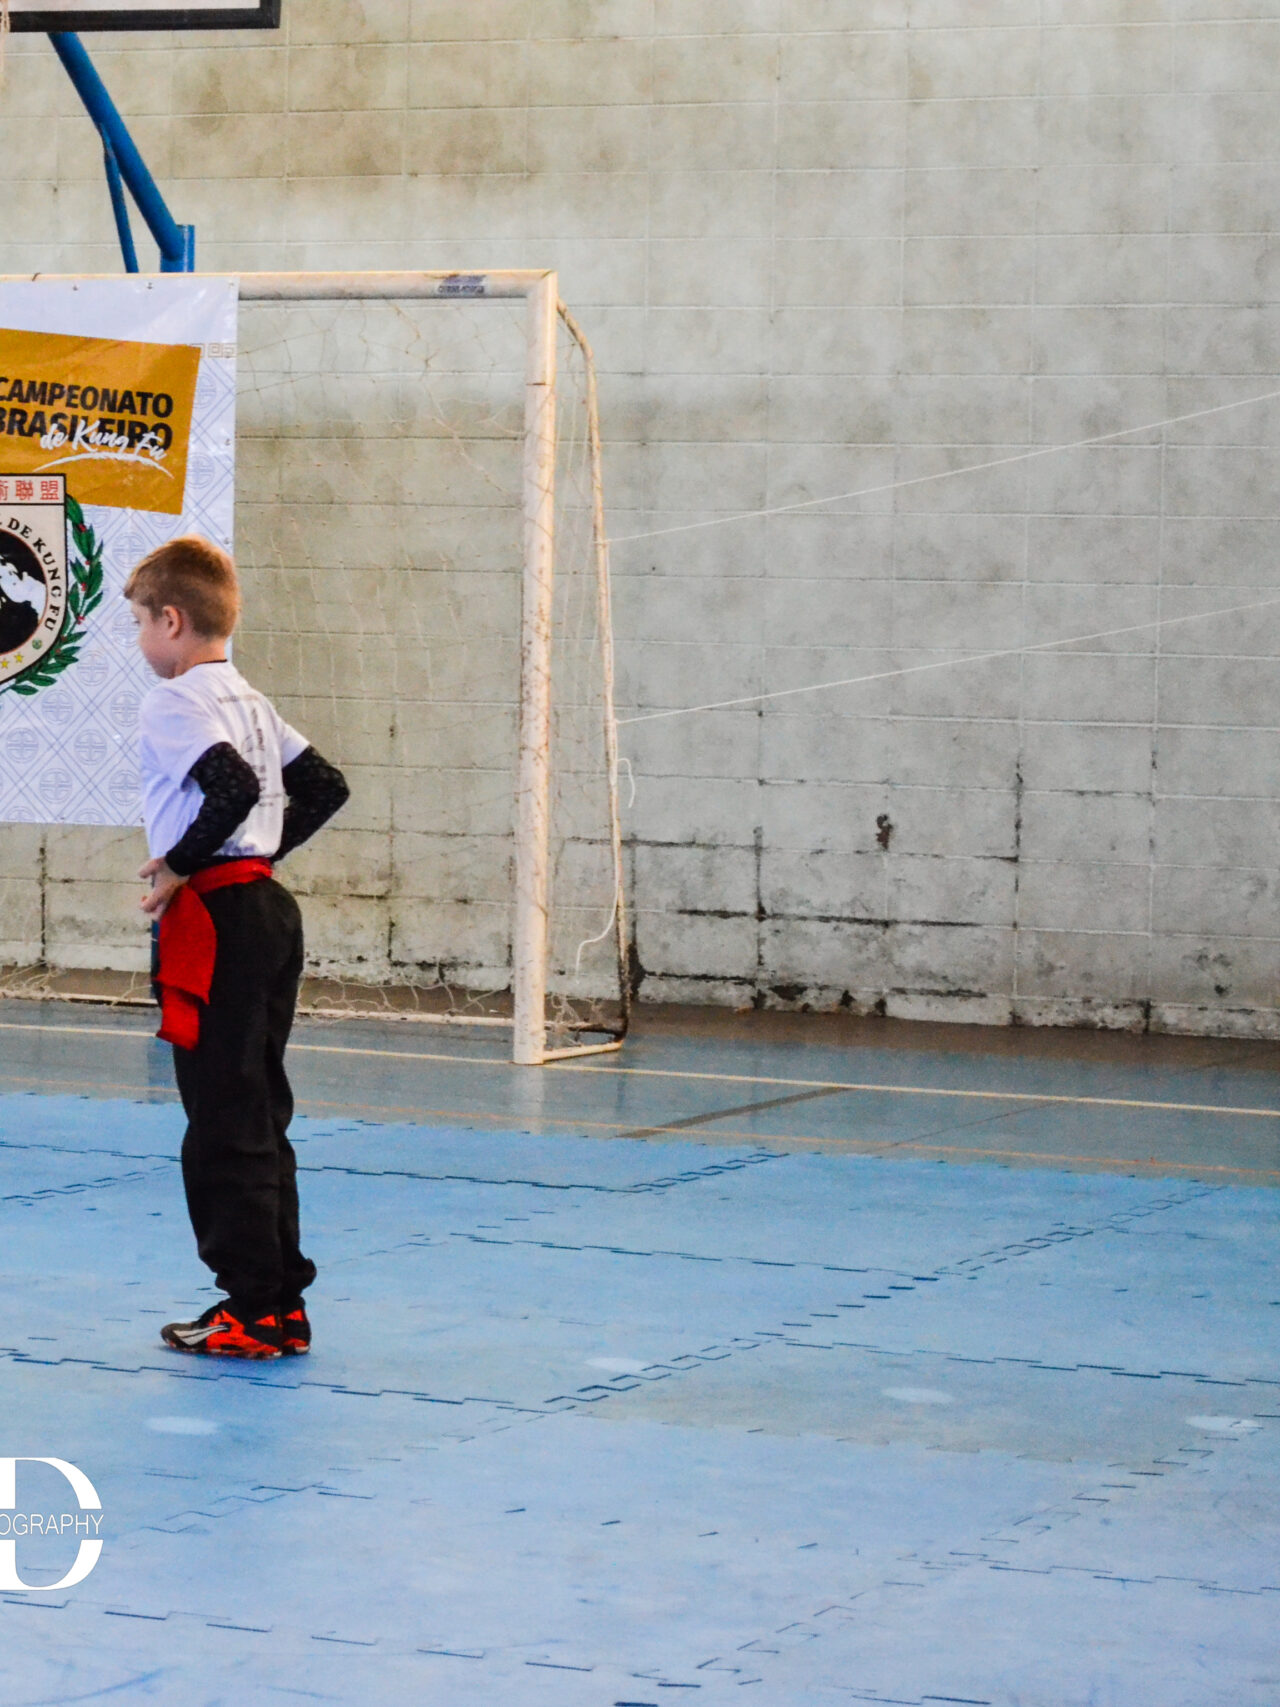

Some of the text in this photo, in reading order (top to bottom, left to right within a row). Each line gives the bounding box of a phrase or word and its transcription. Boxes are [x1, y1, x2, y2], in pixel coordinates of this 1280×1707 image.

[40, 419, 167, 461] de Kung Fu
[7, 517, 33, 539] DE
[33, 537, 62, 599] KUNG
[44, 604, 61, 631] FU
